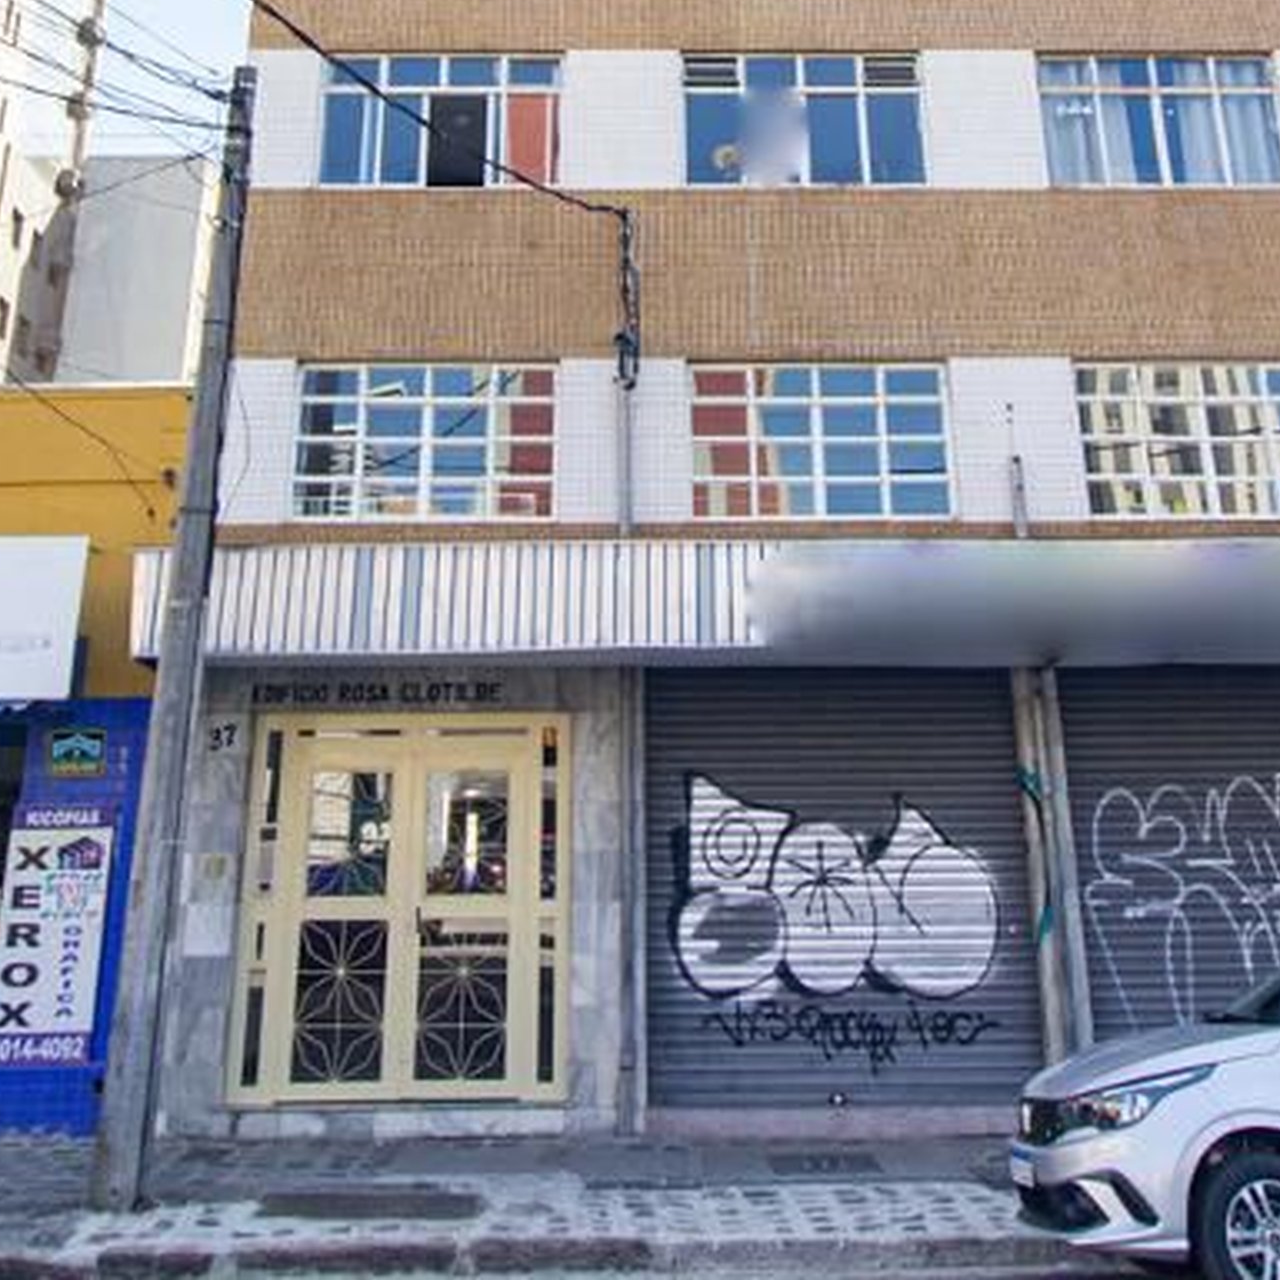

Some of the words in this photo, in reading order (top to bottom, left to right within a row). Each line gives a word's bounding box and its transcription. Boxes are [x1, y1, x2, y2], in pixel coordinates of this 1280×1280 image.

[337, 682, 390, 703] ROSA
[401, 682, 502, 703] CLOTILDE
[209, 723, 238, 751] 37
